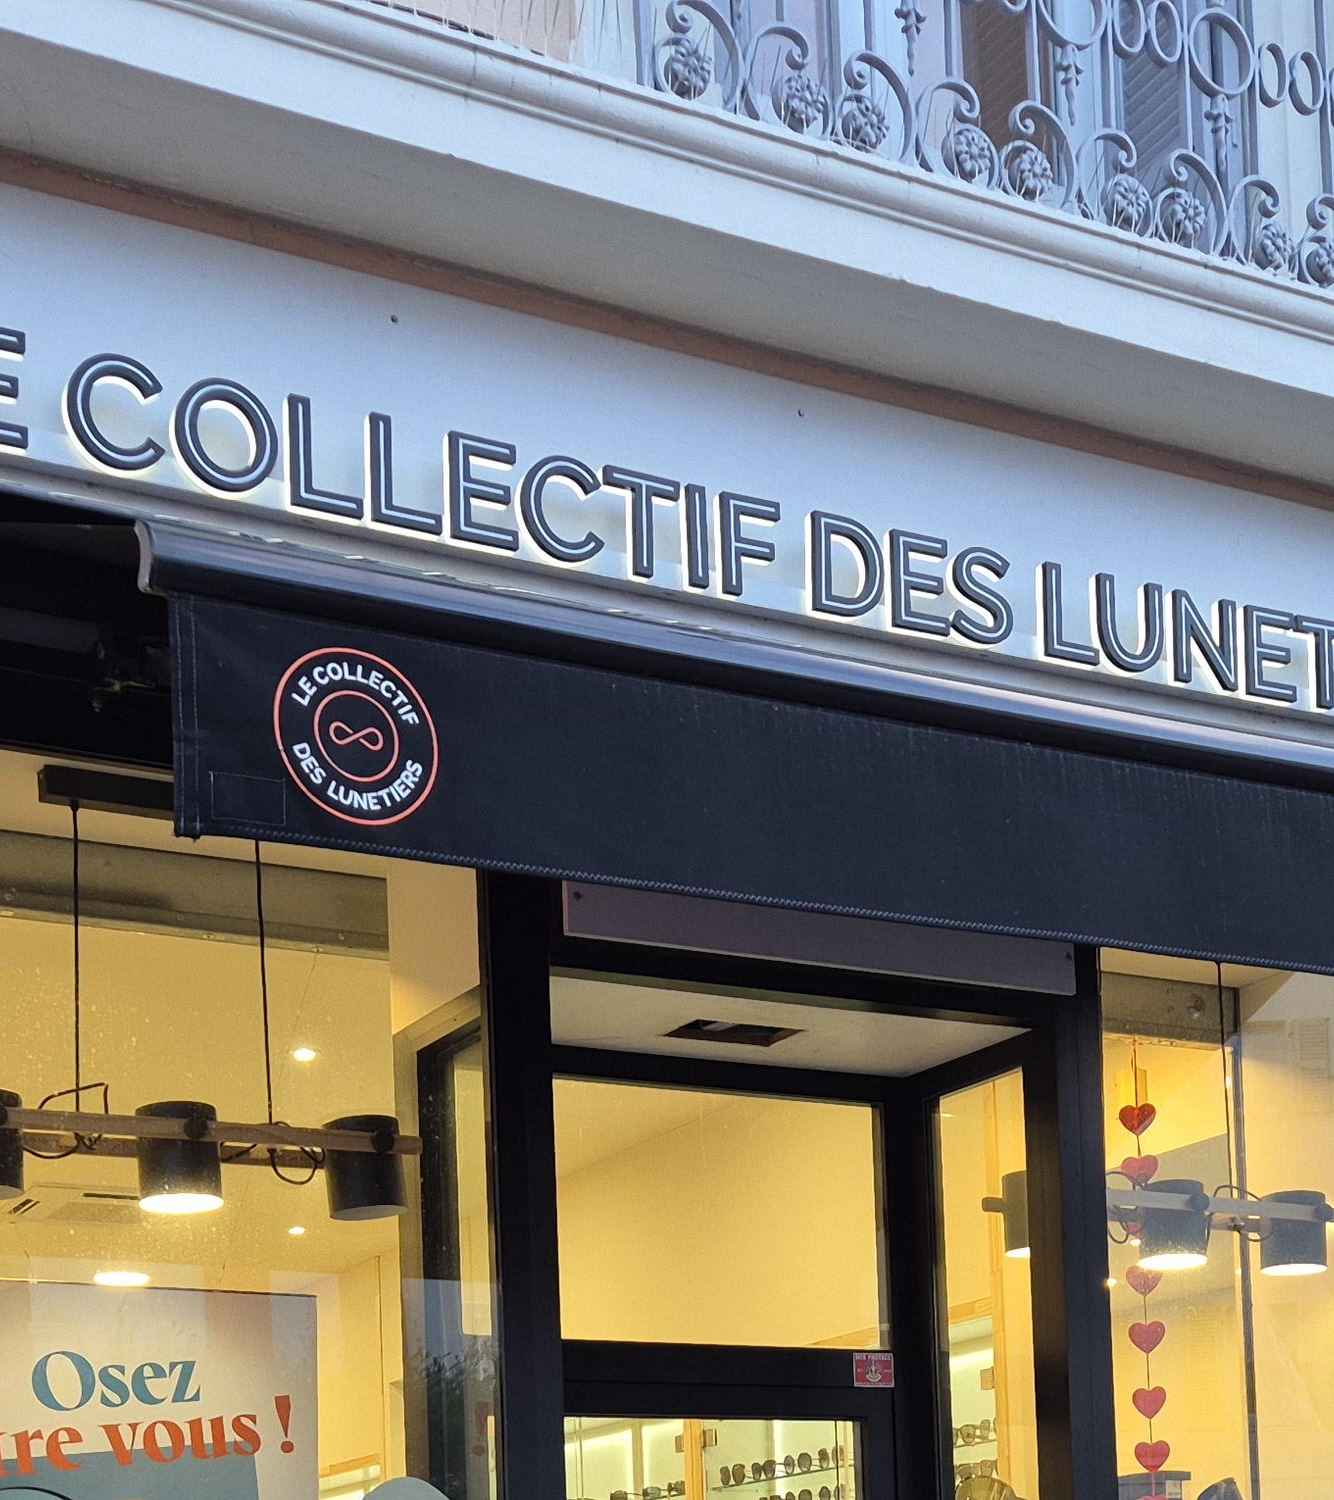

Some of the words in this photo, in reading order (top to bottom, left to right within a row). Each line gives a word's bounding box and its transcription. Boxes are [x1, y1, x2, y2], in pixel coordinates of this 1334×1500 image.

[64, 352, 781, 596] COLLECTIF
[809, 510, 1013, 645] DES
[291, 675, 317, 707] LE
[312, 661, 420, 726] COLLECTIF
[292, 742, 327, 785] DES
[326, 759, 424, 811] LUNETIERS
[31, 1350, 201, 1412] Osez
[97, 1413, 262, 1468] vous
